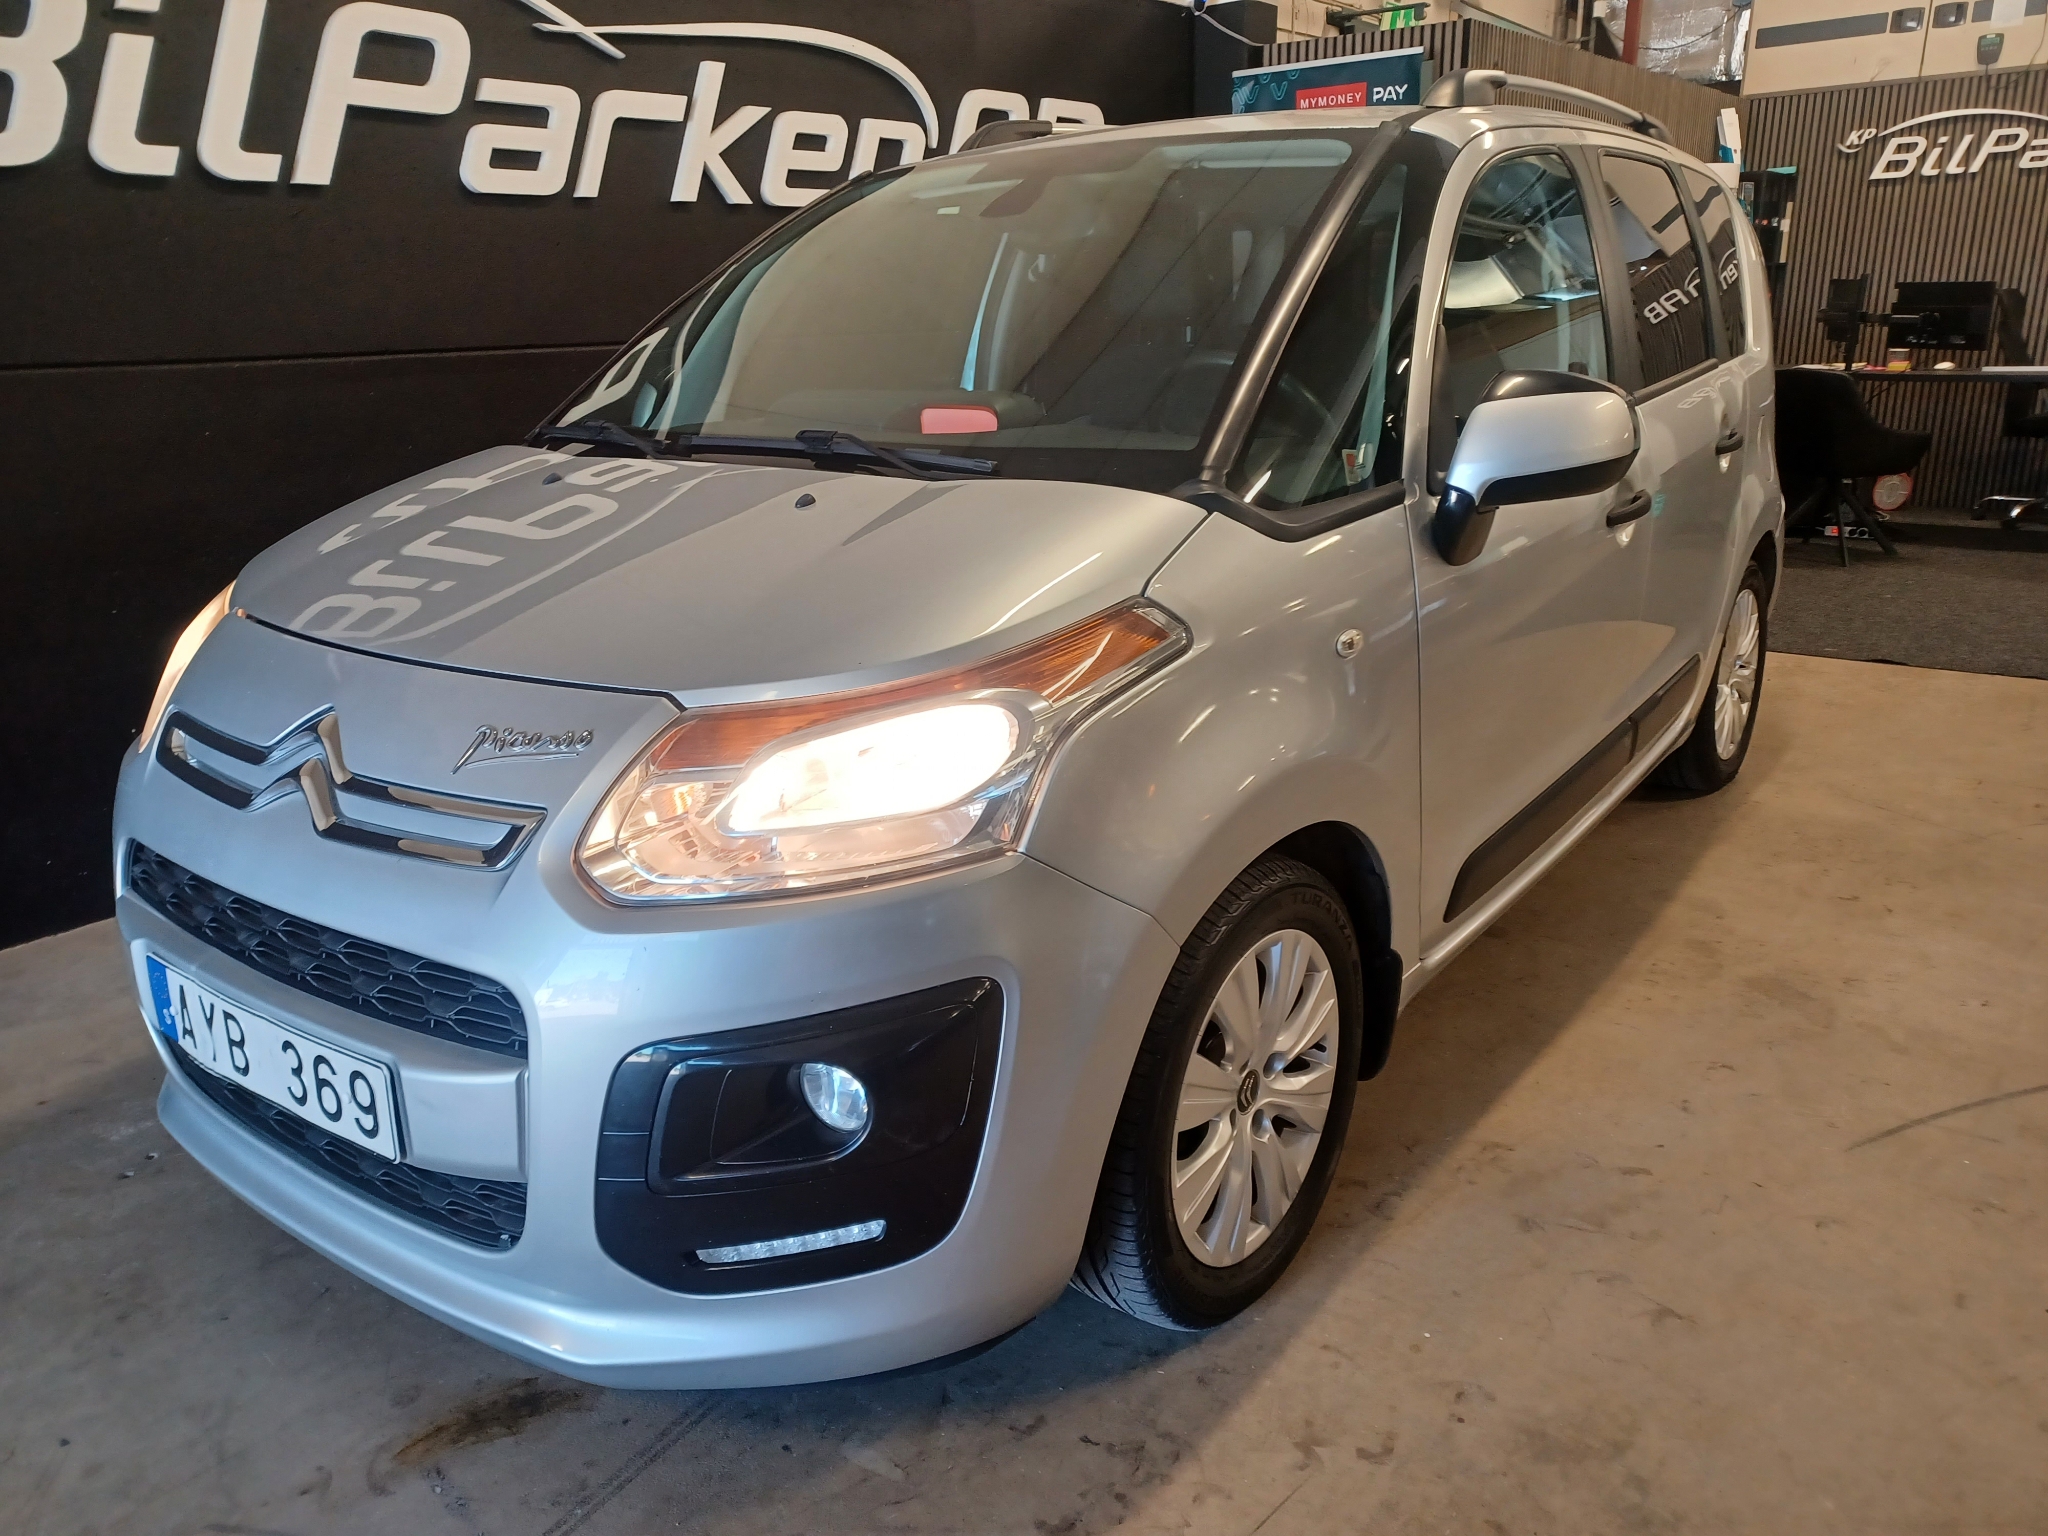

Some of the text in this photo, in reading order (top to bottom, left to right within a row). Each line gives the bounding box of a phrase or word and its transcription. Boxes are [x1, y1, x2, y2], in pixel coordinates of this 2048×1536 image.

[1300, 83, 1408, 109] MYMONEY PAY
[1845, 128, 1877, 146] KP
[450, 724, 595, 775] Picasso
[179, 985, 379, 1139] AYB 369
